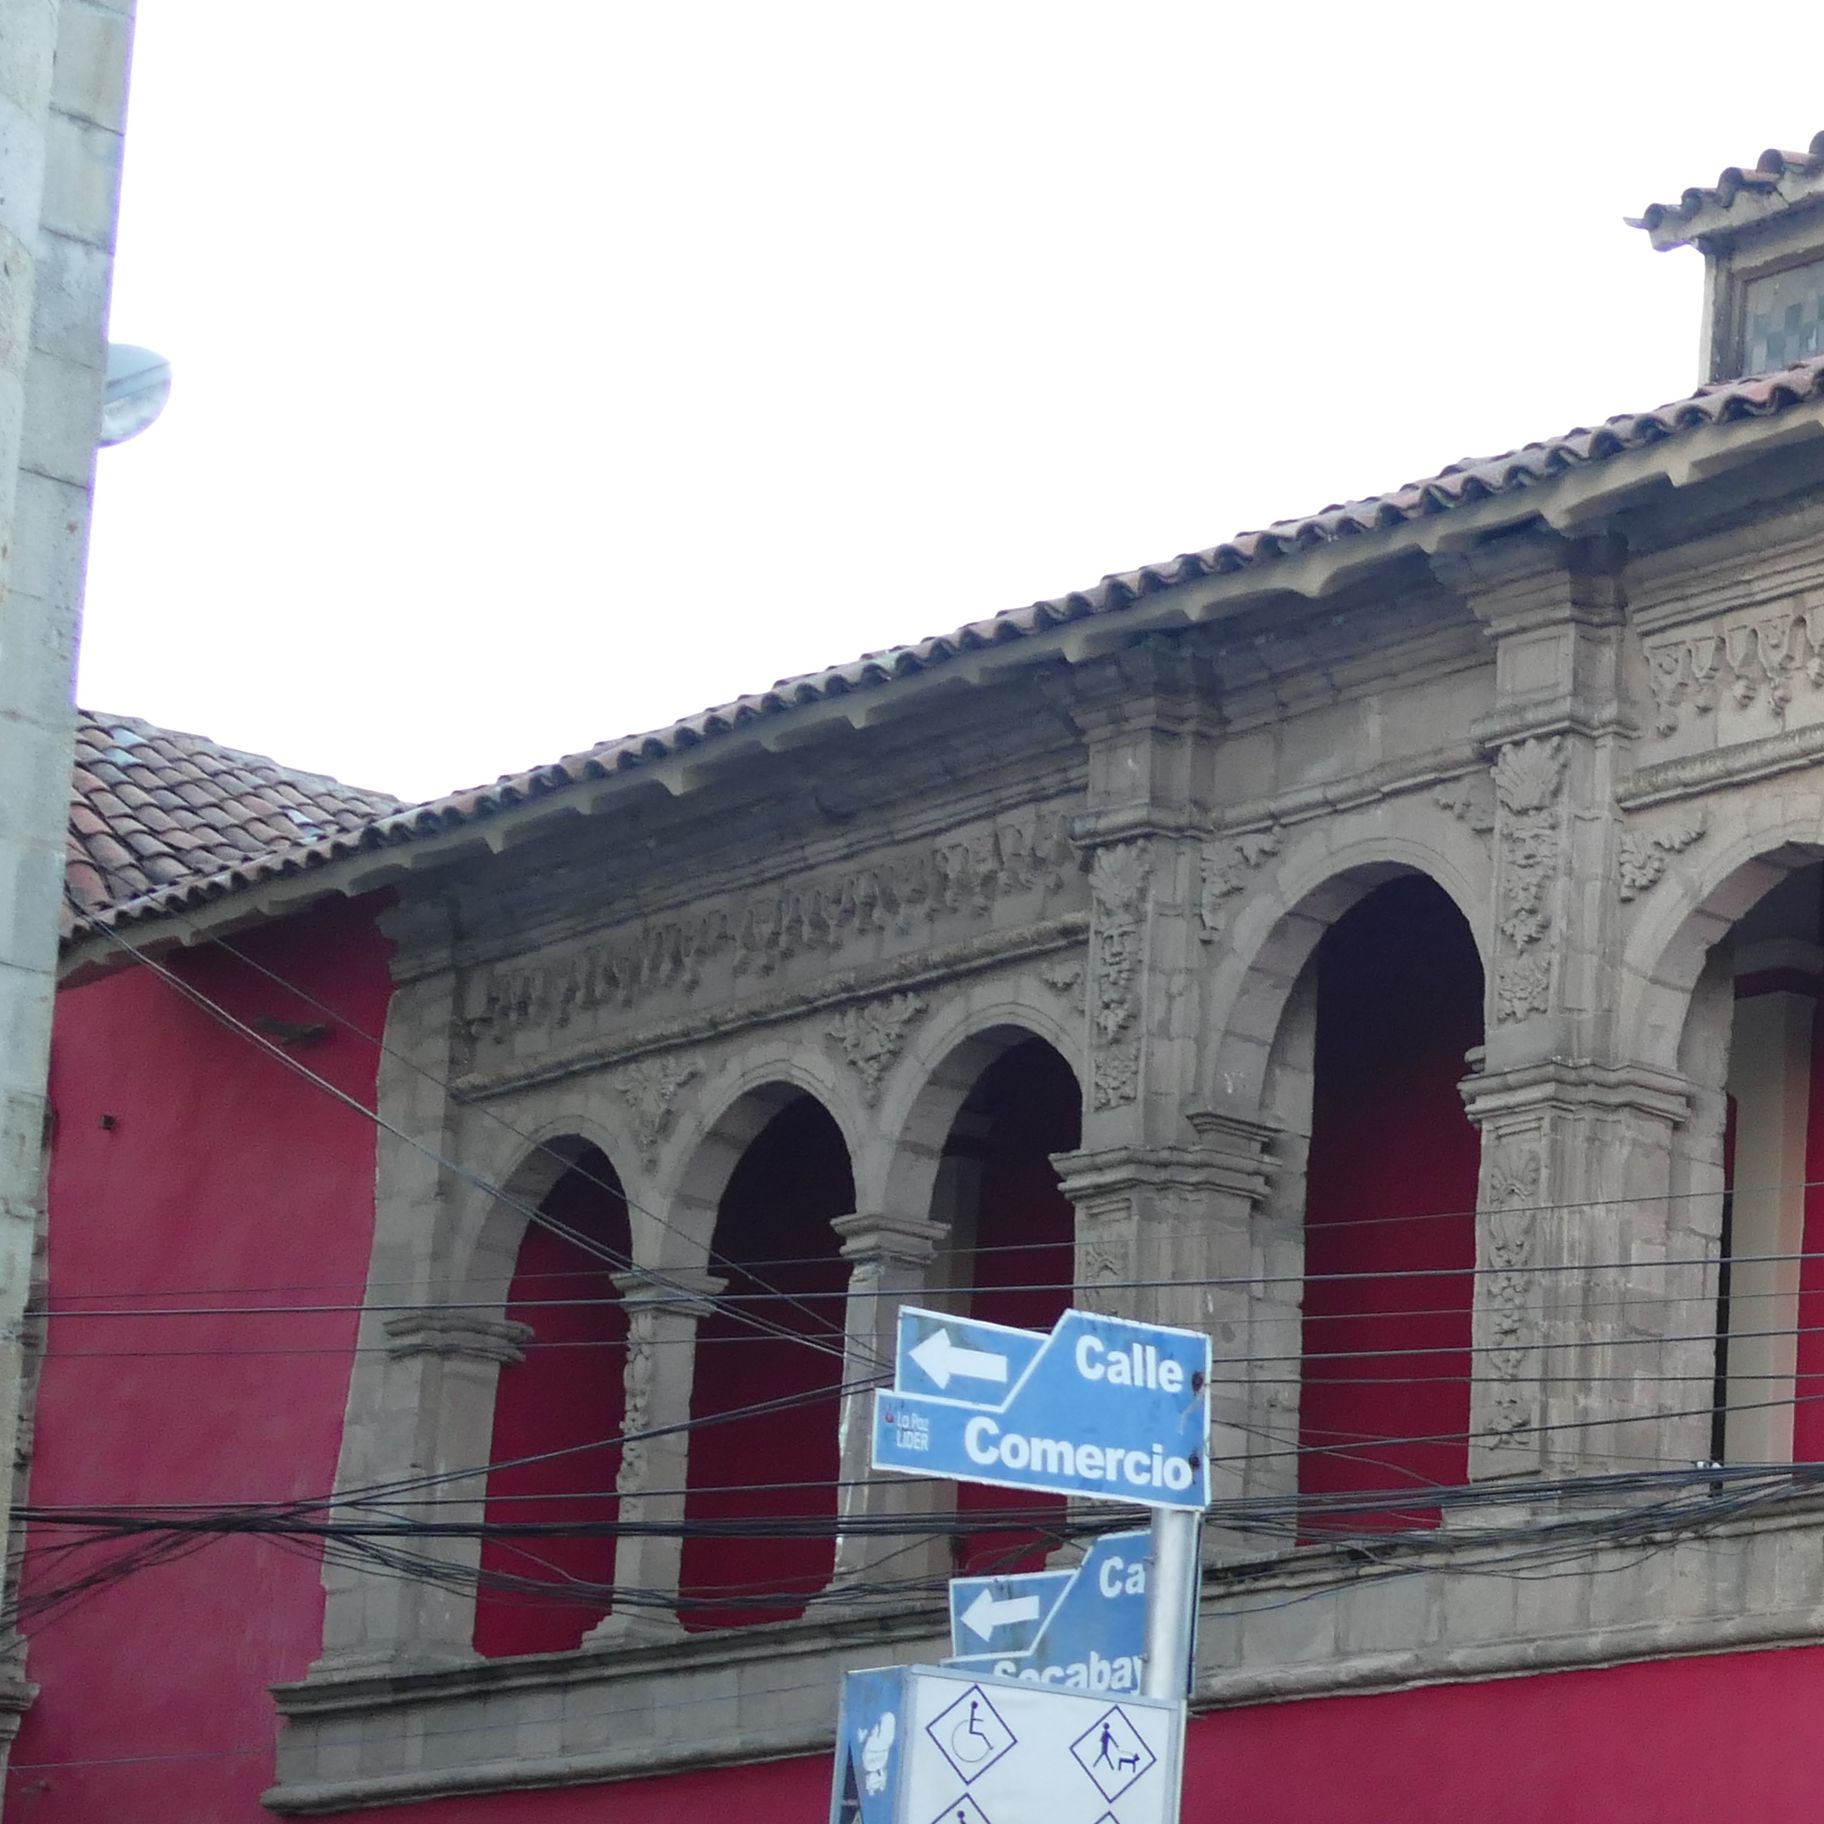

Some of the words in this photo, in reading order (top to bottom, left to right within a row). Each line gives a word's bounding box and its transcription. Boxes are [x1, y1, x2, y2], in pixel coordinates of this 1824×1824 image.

[1075, 1334, 1184, 1394] Calle
[964, 1415, 1193, 1491] Comercio
[1099, 1555, 1146, 1599] Ca
